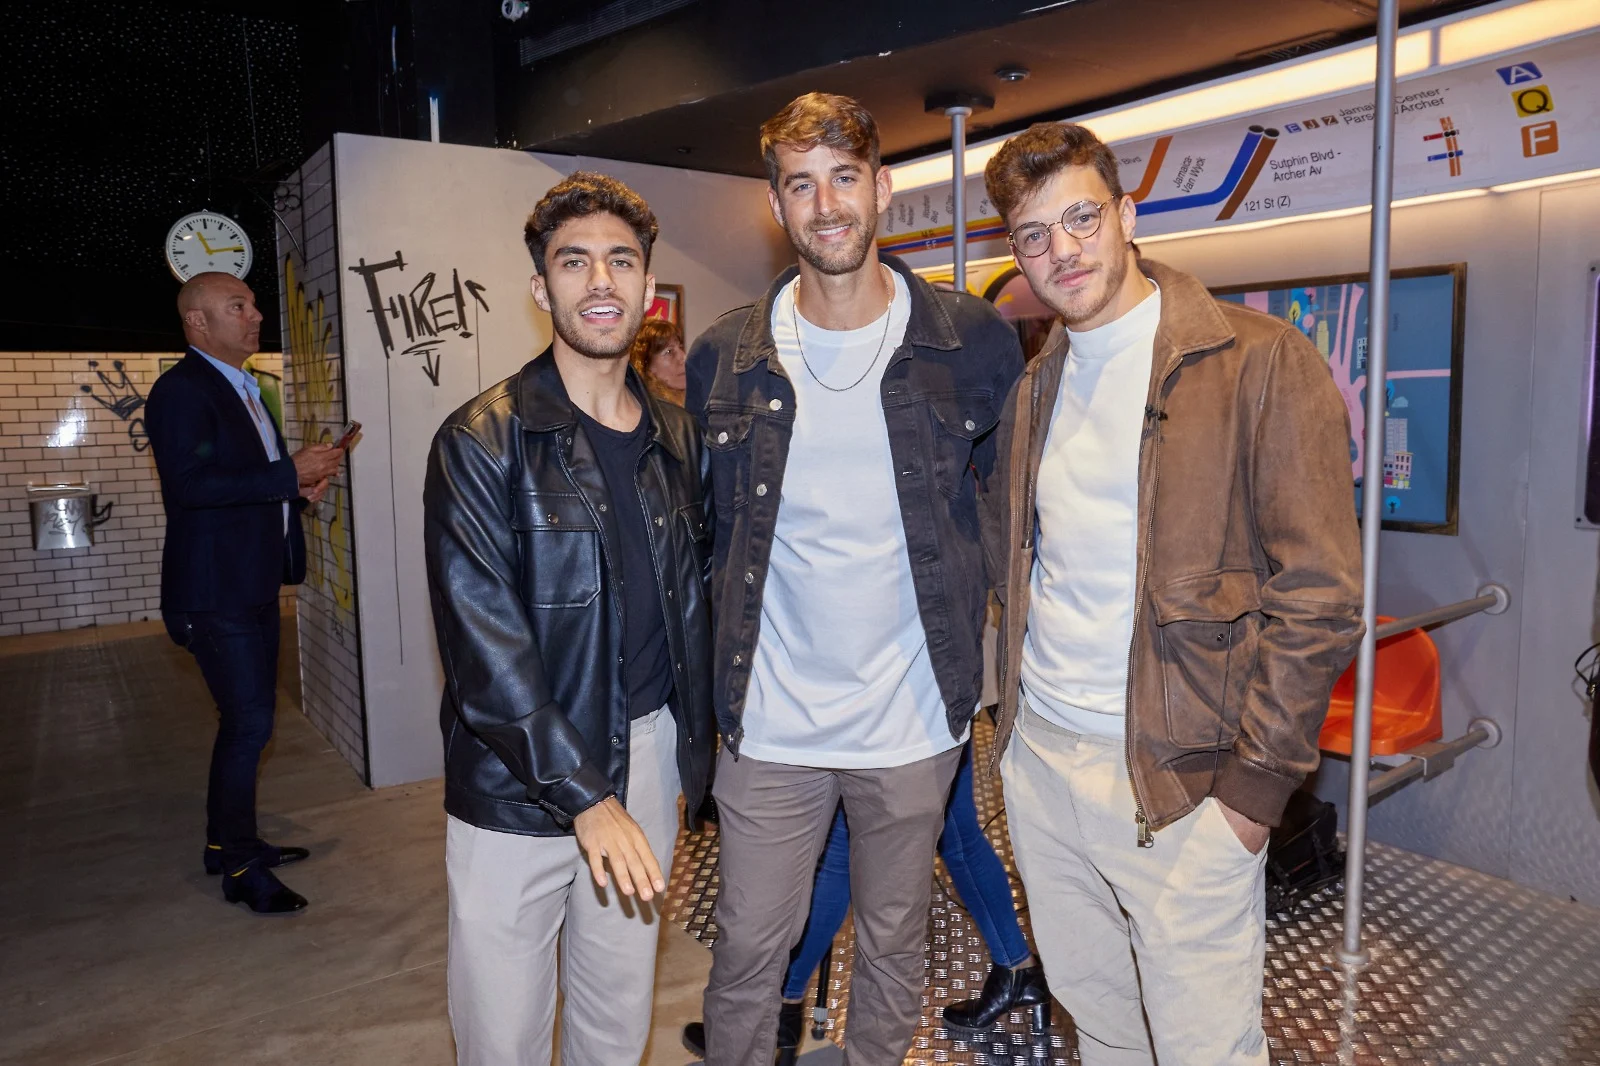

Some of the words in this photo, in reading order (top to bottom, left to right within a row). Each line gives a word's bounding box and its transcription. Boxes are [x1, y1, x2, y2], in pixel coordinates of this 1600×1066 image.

[1510, 66, 1538, 84] A
[1339, 102, 1376, 117] Jamai
[1394, 88, 1440, 104] Center
[1517, 89, 1550, 114] Q
[1529, 124, 1551, 155] F
[1270, 154, 1309, 170] Sutphin
[1311, 149, 1335, 162] Blvd
[1181, 178, 1196, 193] Van
[1190, 157, 1206, 177] Wyck
[1274, 168, 1307, 182] Archer
[1310, 165, 1323, 176] Av
[1245, 201, 1261, 211] 121
[1264, 198, 1275, 209] St
[1277, 196, 1291, 209] (Z)
